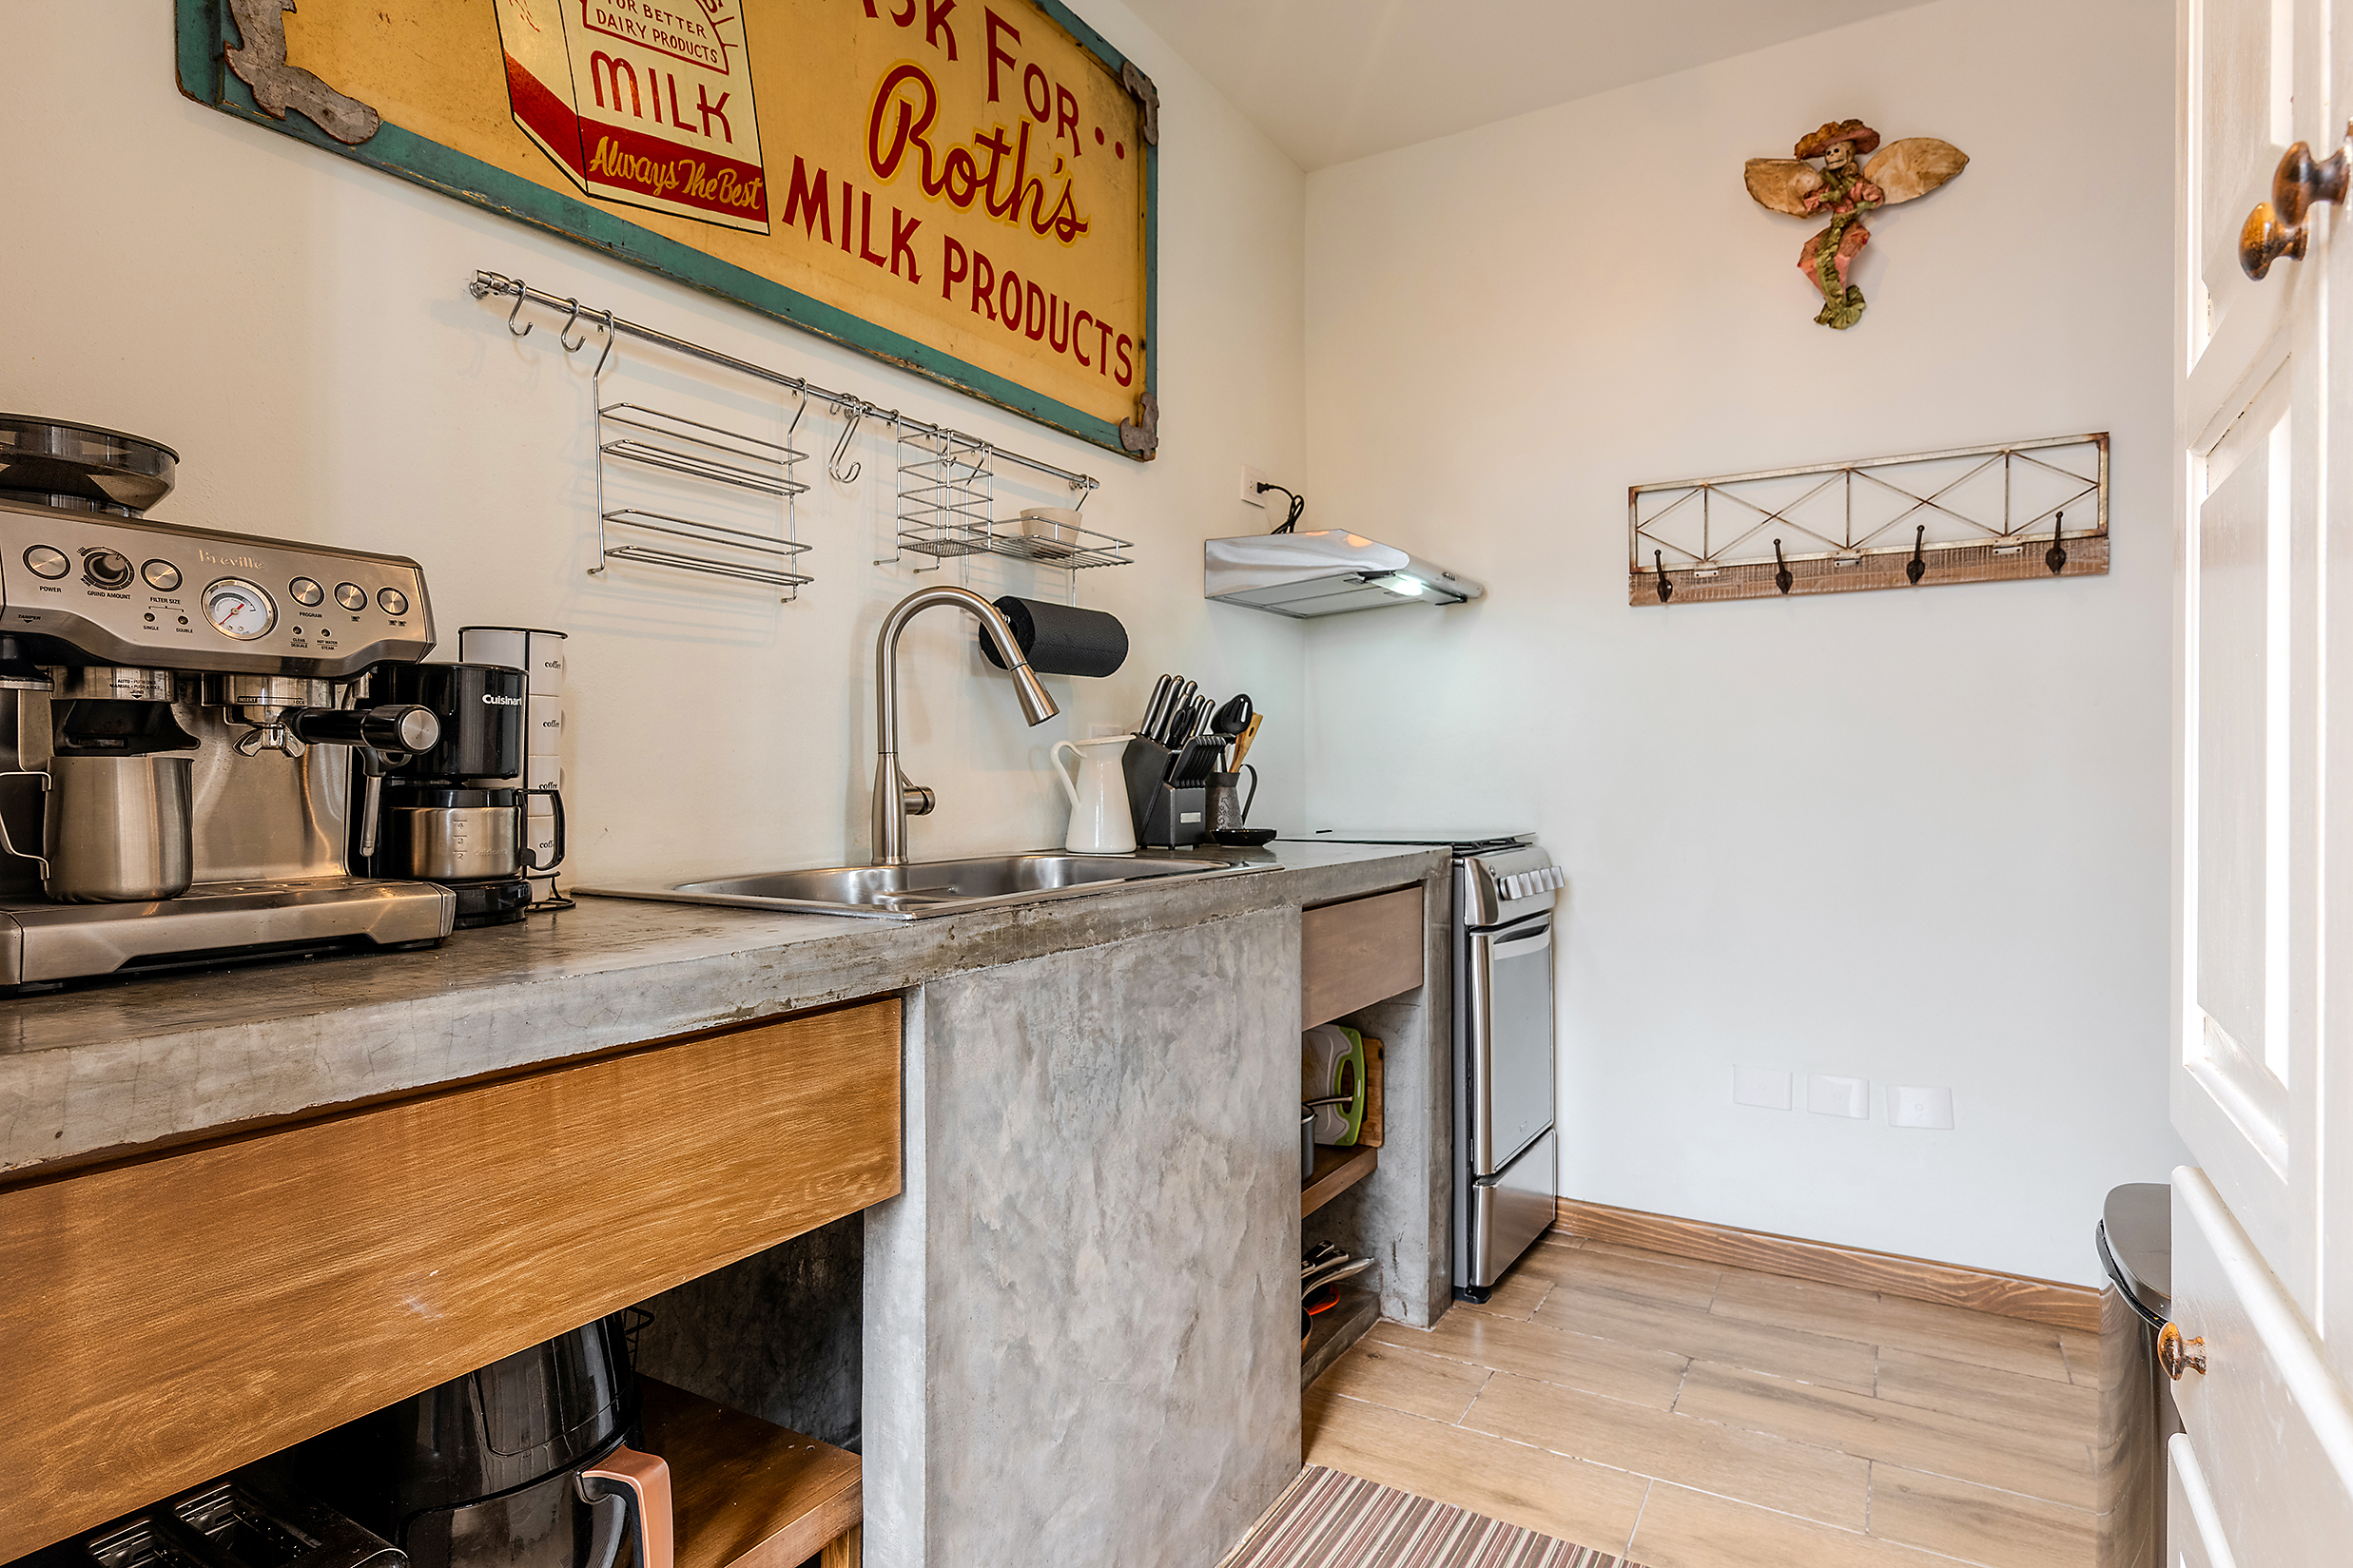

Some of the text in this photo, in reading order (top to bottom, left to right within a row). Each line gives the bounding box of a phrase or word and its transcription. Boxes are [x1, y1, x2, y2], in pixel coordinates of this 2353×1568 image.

[596, 9, 718, 64] DAIRY PRODUCTS
[643, 4, 707, 39] BETTER
[590, 49, 733, 145] MILK
[590, 136, 764, 210] Always The Best
[867, 62, 1089, 244] Roth's
[782, 154, 1133, 387] MILK PRODUCTS
[198, 549, 265, 571] Breville
[481, 693, 522, 707] Cuisinart
[538, 840, 554, 849] coff
